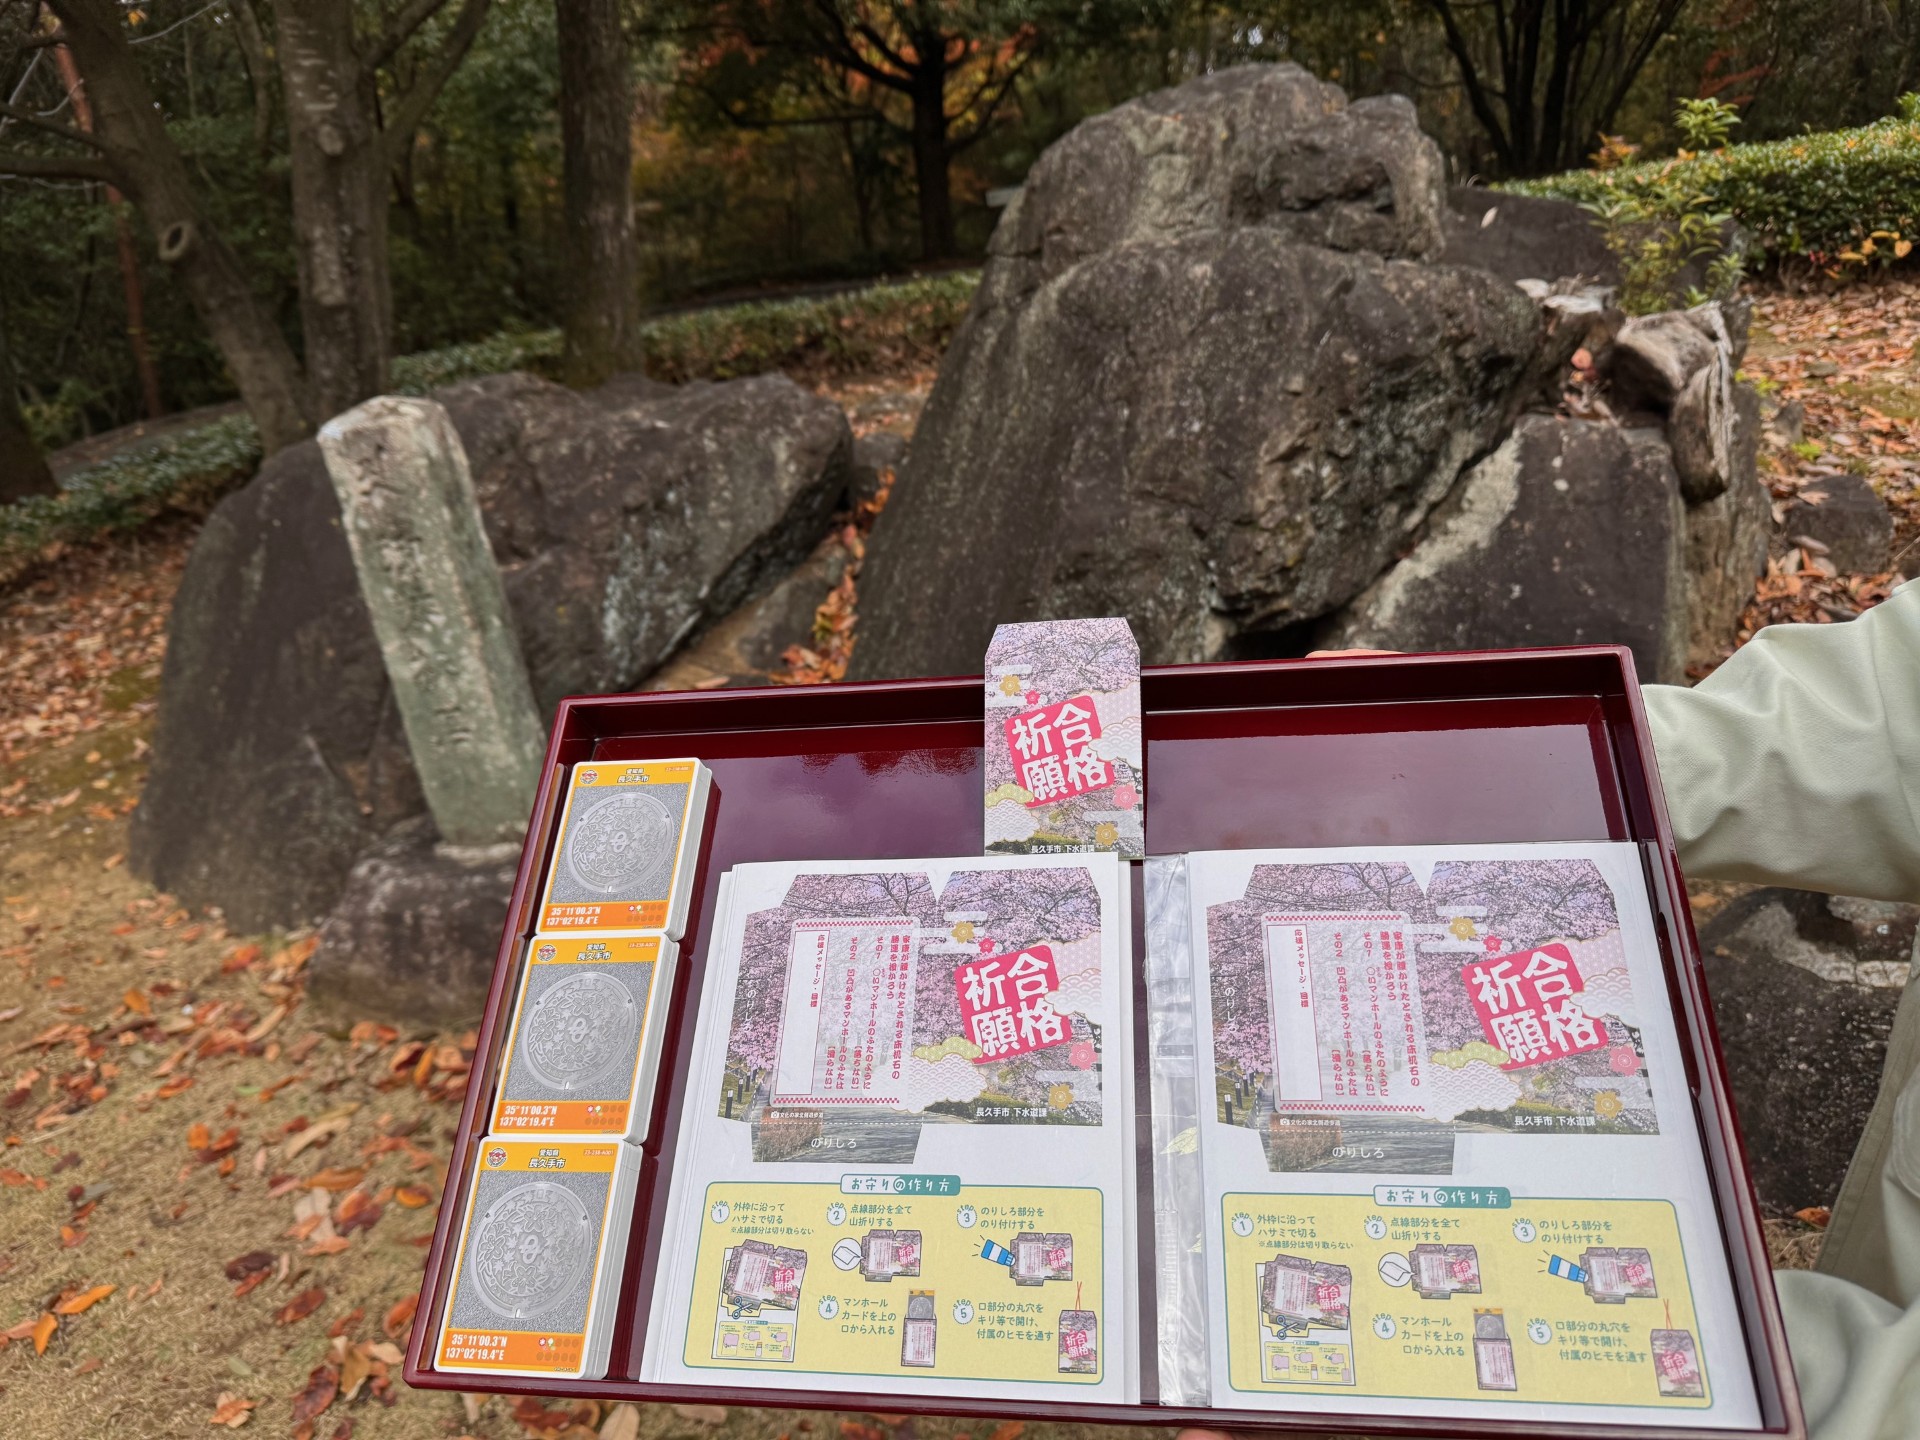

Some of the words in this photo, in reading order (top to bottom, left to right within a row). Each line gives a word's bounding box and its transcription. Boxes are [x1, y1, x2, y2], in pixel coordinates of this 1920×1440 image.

[1053, 703, 1108, 791] 合格
[1011, 712, 1068, 802] 祈願
[617, 775, 650, 783] 長久手市
[1031, 845, 1061, 854] 長久手市
[849, 937, 858, 960] その2
[1334, 932, 1343, 957] その2
[577, 951, 612, 961] 長久手市
[1007, 952, 1063, 1047] 合格
[1522, 951, 1599, 1052] 合格
[962, 962, 1020, 1058] 祈願
[1472, 961, 1552, 1065] 祈願
[976, 1107, 1010, 1117] 長久手市
[1014, 1107, 1047, 1118] 下水道課
[1514, 1116, 1552, 1126] 長久手市
[1557, 1116, 1596, 1127] 下水道課
[811, 1137, 857, 1148] のりしろ
[539, 1149, 560, 1157] 愛知県
[1332, 1147, 1384, 1158] のりしろ
[528, 1158, 566, 1168] 長久手市
[851, 1177, 950, 1192] お守りの作り方
[1387, 1190, 1498, 1205] お守りの作り方
[733, 1202, 785, 1212] 外枠に沿って
[850, 1204, 912, 1214] 点線部分を全て
[981, 1207, 1045, 1217] のりしろ部分を
[732, 1214, 783, 1224] ハサミで切る
[849, 1217, 893, 1226] 山折りする
[981, 1220, 1035, 1229] のり付けする
[1257, 1215, 1315, 1225] 外枠に沿って
[1390, 1218, 1460, 1228] 点線部分を全て
[1540, 1220, 1612, 1231] のりしろ部分を
[1258, 1228, 1317, 1238] ハサミで切る
[1391, 1231, 1441, 1240] 山折りする
[1541, 1234, 1604, 1244] のり付けする
[843, 1298, 888, 1308] マンホール
[978, 1302, 1044, 1313] 口部分の丸穴を
[842, 1311, 897, 1321] カードを上の
[978, 1316, 1039, 1327] キリ等で開け、
[1400, 1317, 1452, 1327] マンホール
[1556, 1321, 1631, 1332] 口部分の丸穴を
[841, 1324, 895, 1335] 口から入れる
[977, 1329, 1053, 1341] 付属のヒモを通す
[1401, 1330, 1464, 1341] カードを上の
[1558, 1336, 1628, 1347] キリ等で開け、
[1403, 1345, 1464, 1356] 口から入れる
[1560, 1351, 1647, 1363] 付属のヒモを通す
